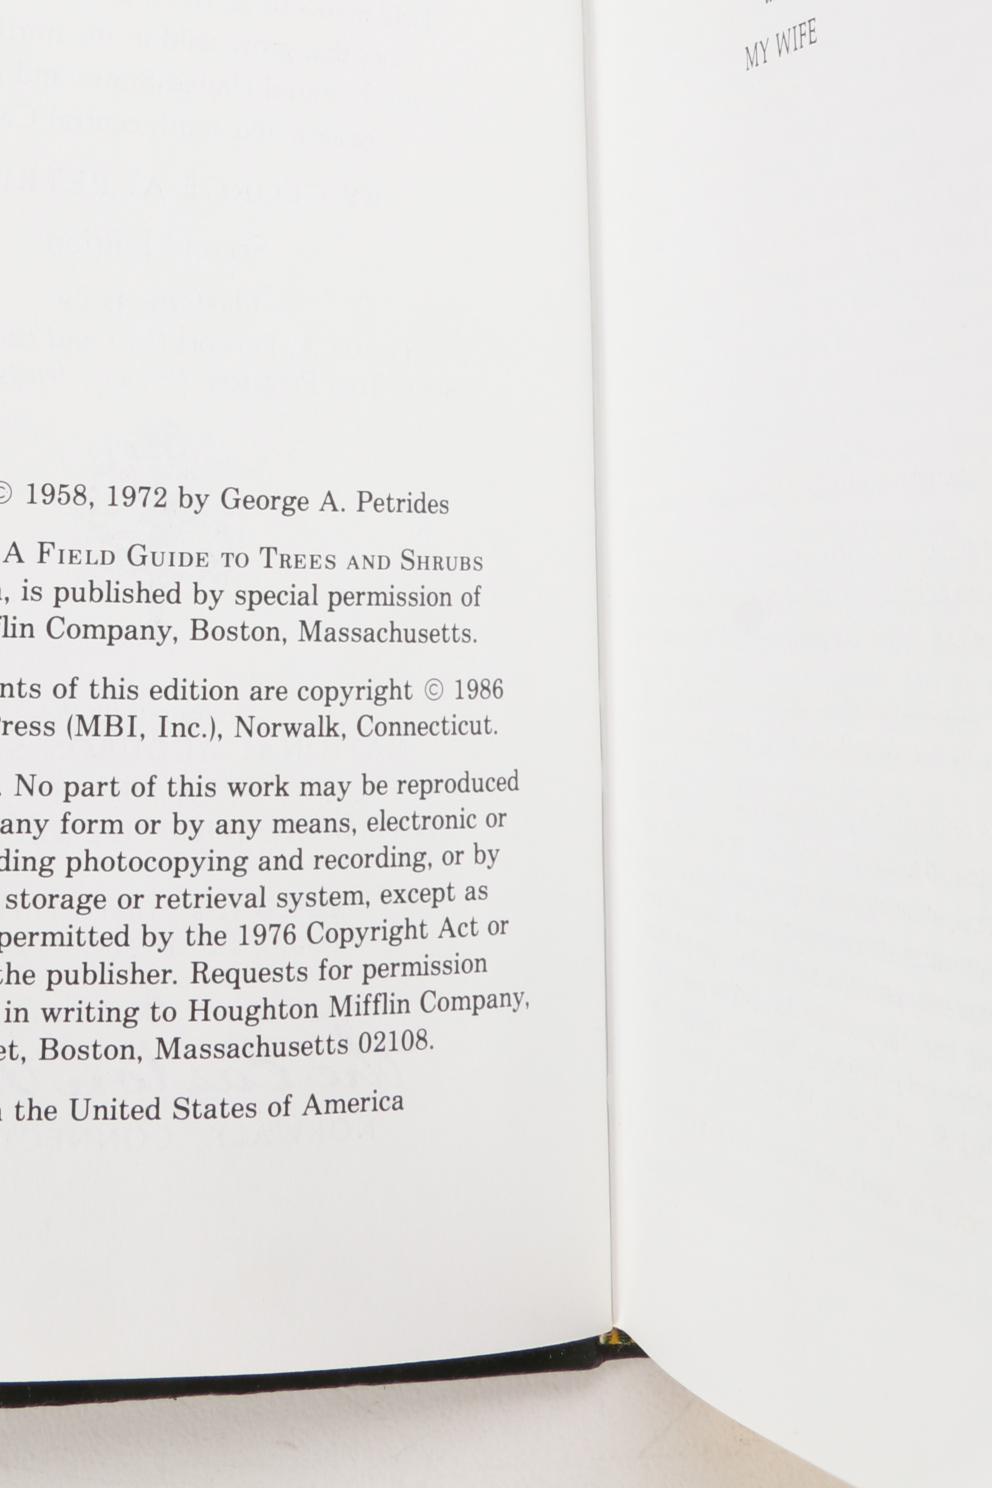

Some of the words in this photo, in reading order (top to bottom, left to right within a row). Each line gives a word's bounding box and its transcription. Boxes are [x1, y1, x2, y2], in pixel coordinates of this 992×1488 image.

[745, 37, 769, 72] MY
[775, 17, 818, 58] WIFE
[26, 482, 95, 511] 1958,
[107, 484, 168, 509] 1972
[177, 484, 211, 516] by
[220, 486, 310, 518] George
[318, 489, 346, 513] A.
[356, 489, 450, 515] Petrides
[1, 540, 26, 564] A
[20, 577, 43, 602] is
[52, 578, 183, 609] published
[191, 580, 225, 612] by
[234, 582, 319, 612] special
[327, 583, 453, 613] permission
[460, 584, 483, 608] of
[45, 615, 179, 648] Company,
[189, 617, 288, 646] Boston,
[297, 619, 478, 645] Massachusetts.
[52, 675, 80, 700] of
[88, 675, 139, 701] this
[149, 677, 240, 702] edition
[249, 685, 289, 702] are
[296, 677, 414, 708] copyright
[455, 677, 504, 701] 1986
[66, 713, 146, 742] (MBI,
[157, 714, 223, 743] Inc.),
[233, 714, 347, 742] Norwalk,
[356, 713, 498, 738] Connecticut.
[13, 773, 54, 798] No
[62, 775, 121, 804] part
[130, 773, 159, 798] of
[166, 773, 217, 799] this
[226, 773, 291, 798] work
[299, 780, 353, 803] may
[360, 772, 389, 797] be
[396, 768, 520, 801] reproduced
[0, 817, 51, 841] any
[59, 810, 125, 836] form
[134, 818, 162, 836] or
[171, 811, 206, 842] by
[214, 818, 263, 841] any
[271, 816, 357, 837] means,
[366, 806, 478, 833] electronic
[485, 812, 508, 829] or
[64, 847, 250, 879] photocopying
[257, 847, 305, 872] and
[312, 844, 433, 874] recording,
[441, 849, 465, 867] or
[472, 841, 501, 871] by
[5, 887, 107, 917] storage
[116, 892, 145, 911] or
[154, 884, 267, 910] retrieval
[276, 885, 371, 915] system,
[379, 881, 457, 910] except
[464, 884, 489, 902] as
[140, 923, 175, 954] by
[184, 922, 228, 948] the
[238, 922, 297, 947] 1976
[306, 916, 429, 950] Copyright
[437, 915, 480, 940] Act
[487, 919, 510, 937] or
[45, 960, 178, 992] publisher.
[189, 960, 309, 991] Requests
[317, 957, 354, 982] for
[361, 951, 488, 986] permission
[3, 999, 30, 1024] in
[40, 999, 141, 1030] writing
[149, 1000, 178, 1023] to
[187, 996, 320, 1028] Houghton
[328, 991, 412, 1019] Mifflin
[419, 989, 530, 1017] Company,
[37, 1037, 143, 1065] Boston,
[154, 1033, 349, 1061] Massachusetts
[358, 1027, 434, 1055] 02108.
[14, 1096, 58, 1122] the
[68, 1096, 162, 1122] United
[172, 1096, 258, 1121] States
[267, 1093, 294, 1118] of
[301, 1088, 405, 1117] America
